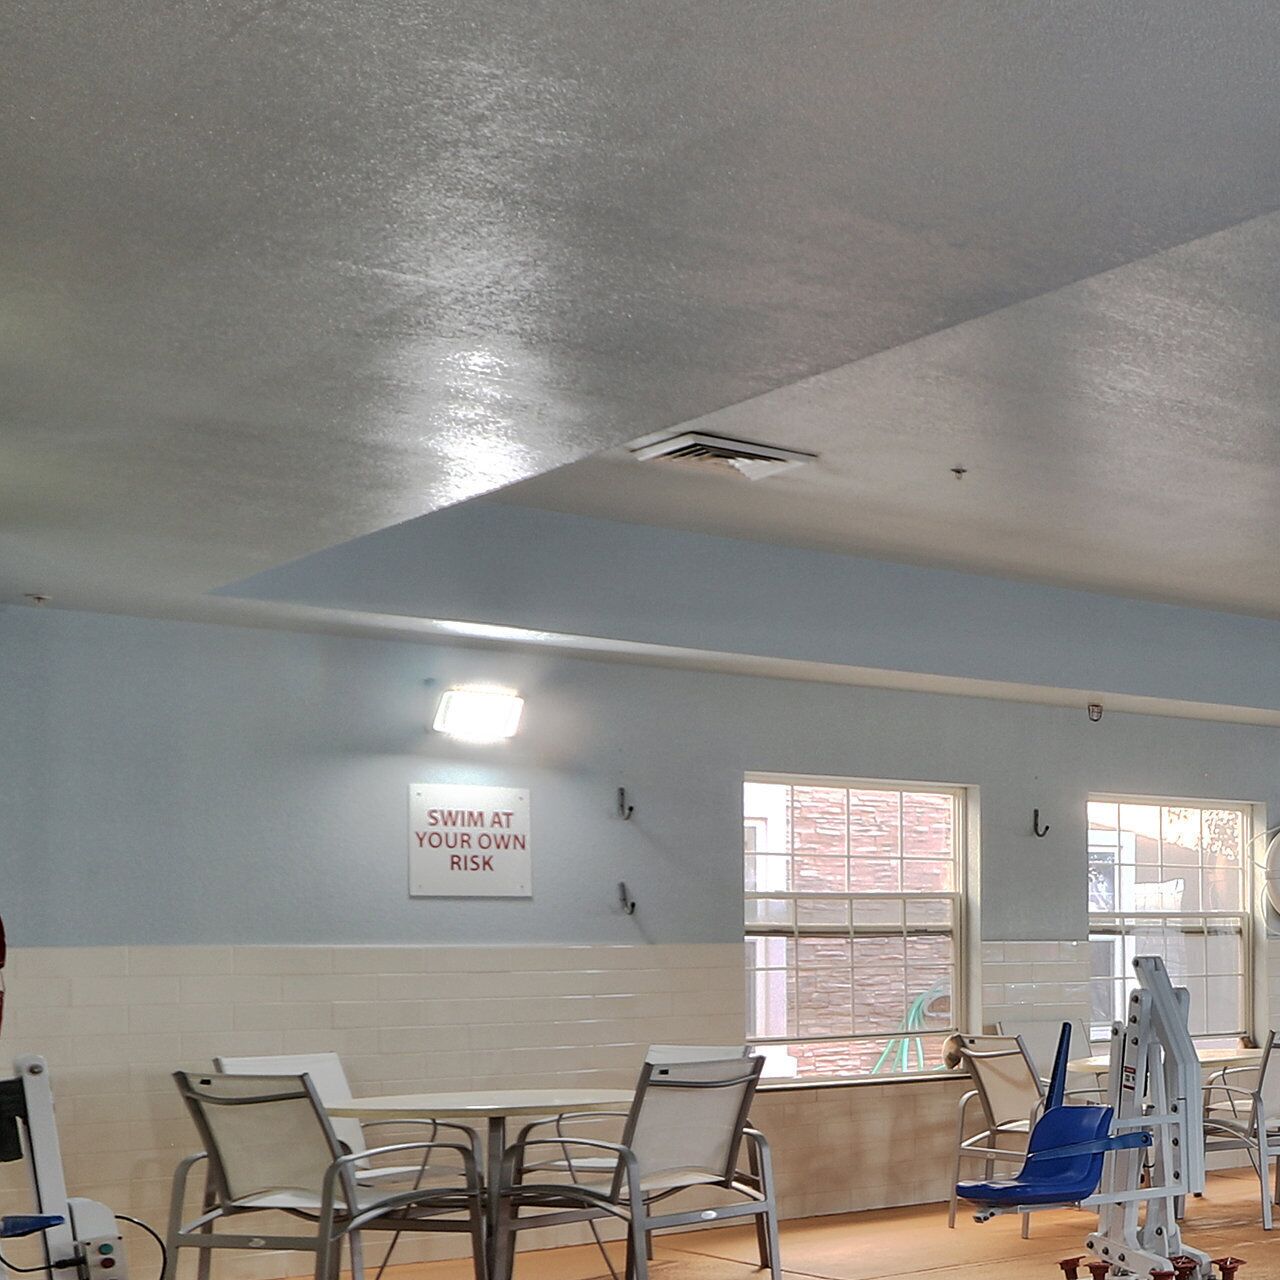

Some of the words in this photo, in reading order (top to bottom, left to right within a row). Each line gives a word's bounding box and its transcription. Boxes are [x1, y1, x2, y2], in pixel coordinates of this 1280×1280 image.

[427, 809, 485, 828] SWIM
[490, 812, 514, 828] AT
[415, 832, 471, 849] YOUR
[478, 834, 526, 850] OWN
[450, 855, 494, 871] RISK
